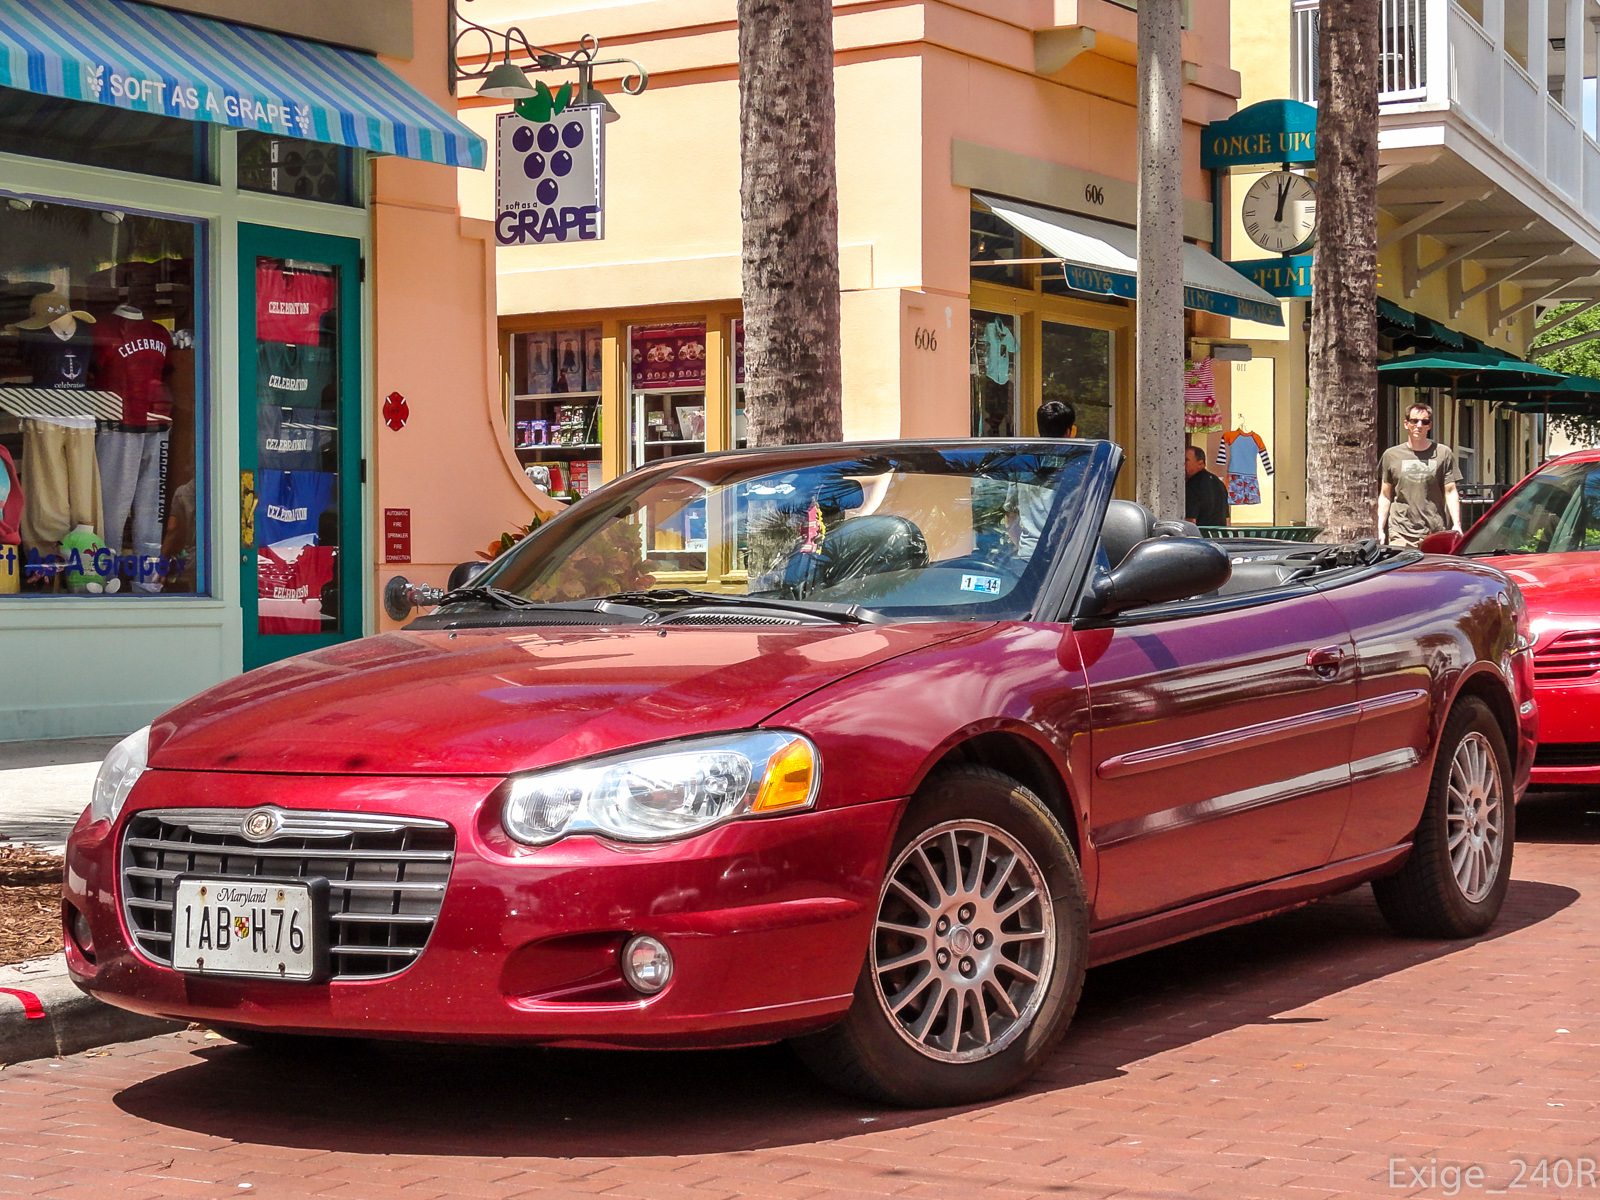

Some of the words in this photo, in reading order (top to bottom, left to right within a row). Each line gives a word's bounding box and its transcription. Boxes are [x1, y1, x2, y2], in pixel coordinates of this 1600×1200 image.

[110, 74, 166, 104] SOFT
[171, 85, 199, 110] AS
[205, 91, 220, 113] A
[224, 95, 294, 127] GRAPE
[1278, 130, 1316, 152] UPO
[1085, 183, 1104, 205] 606
[505, 201, 520, 210] soft
[495, 205, 597, 244] GRAPE
[1071, 267, 1113, 290] TOYS
[1252, 266, 1313, 288] TIM
[915, 326, 937, 351] 606
[25, 547, 58, 576] As
[65, 547, 85, 576] A
[93, 547, 170, 584] Grape
[216, 888, 268, 907] Maryland
